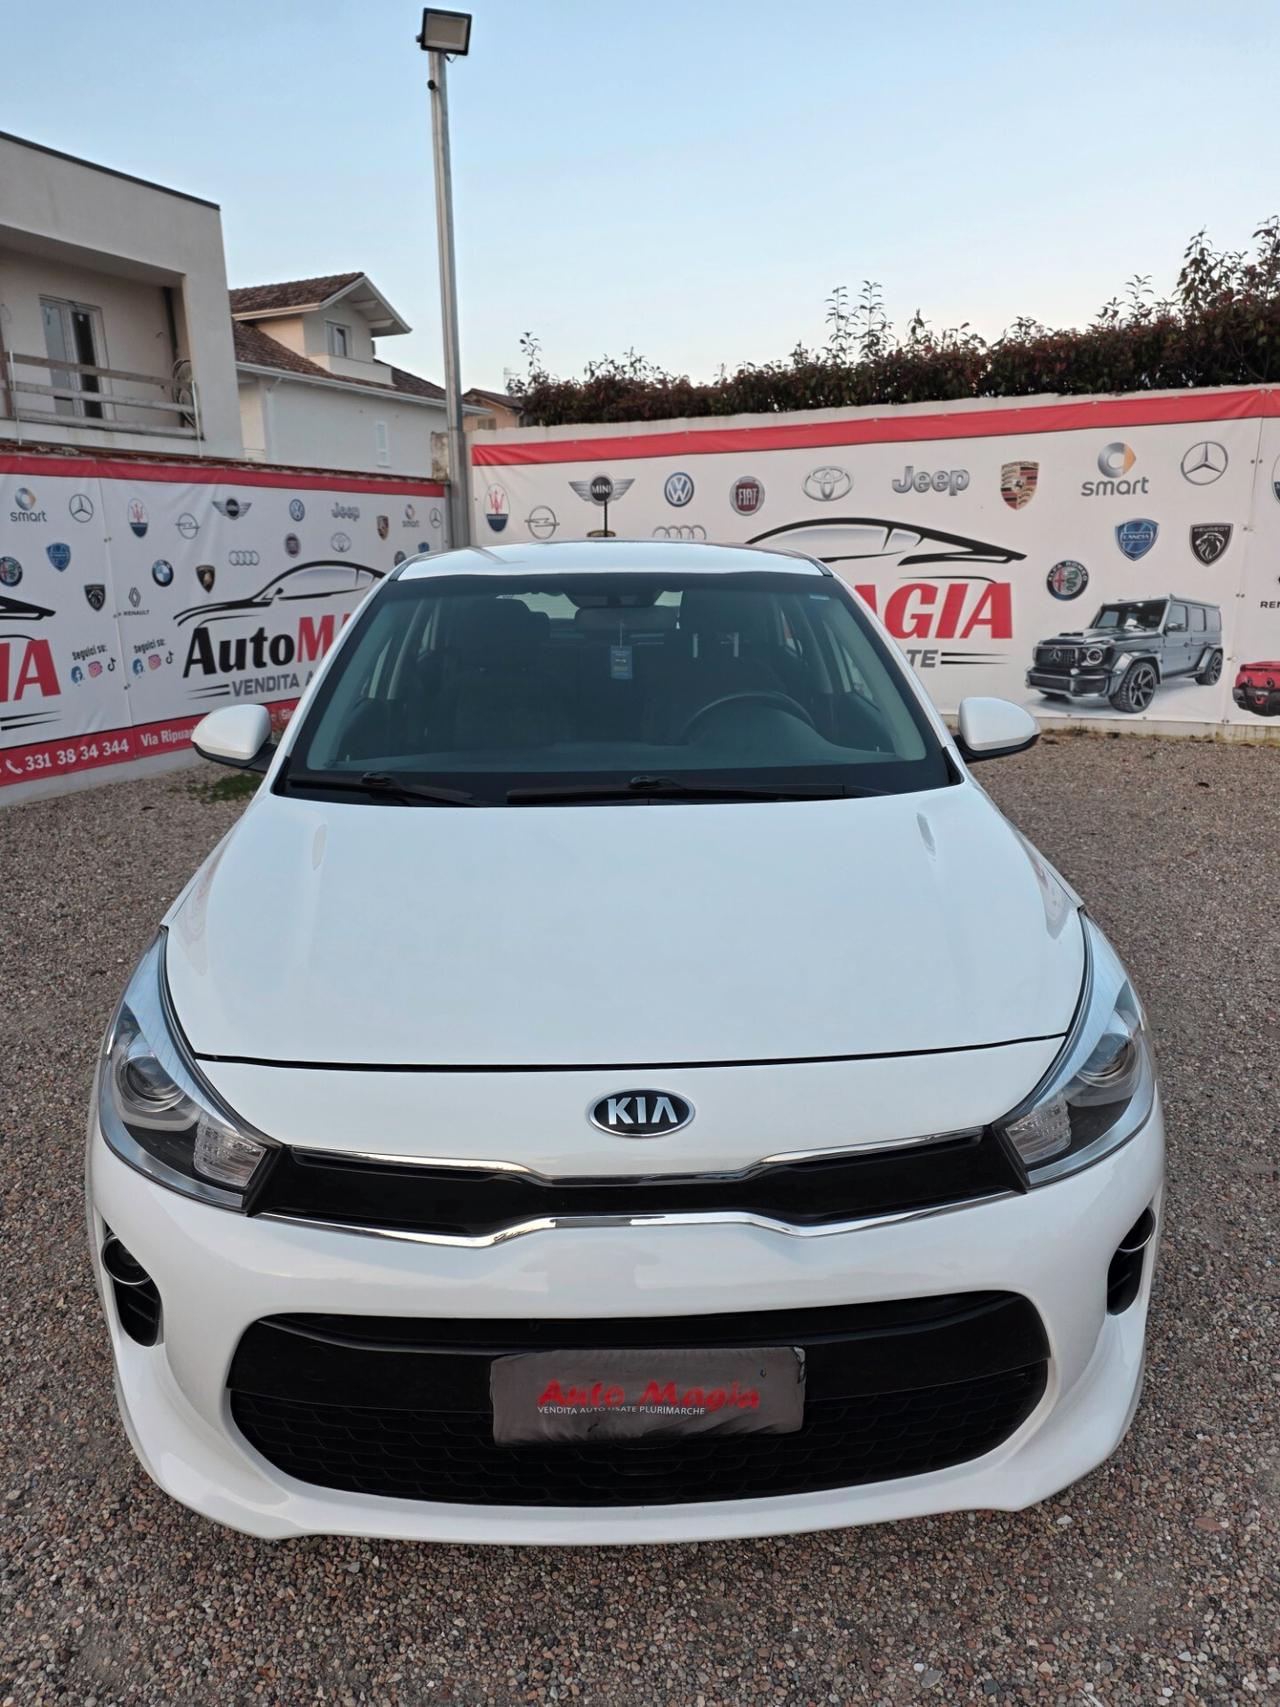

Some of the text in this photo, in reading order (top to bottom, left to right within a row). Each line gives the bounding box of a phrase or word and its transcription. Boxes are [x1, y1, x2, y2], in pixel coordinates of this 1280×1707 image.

[591, 484, 613, 495] MINI
[892, 465, 970, 496] Jeep
[1081, 476, 1149, 497] smart
[738, 488, 757, 506] FIAT
[10, 511, 47, 522] smart
[331, 502, 360, 522] Jeep
[183, 613, 351, 678] AutoM
[232, 674, 299, 697] VENDITA
[141, 729, 158, 747] Via
[25, 738, 129, 771] 331 38 34 344
[607, 1096, 678, 1125] KIA
[537, 1377, 761, 1413] Auto Magia
[537, 1406, 578, 1415] VENDITA
[640, 1406, 705, 1416] PLURIMARCHE
